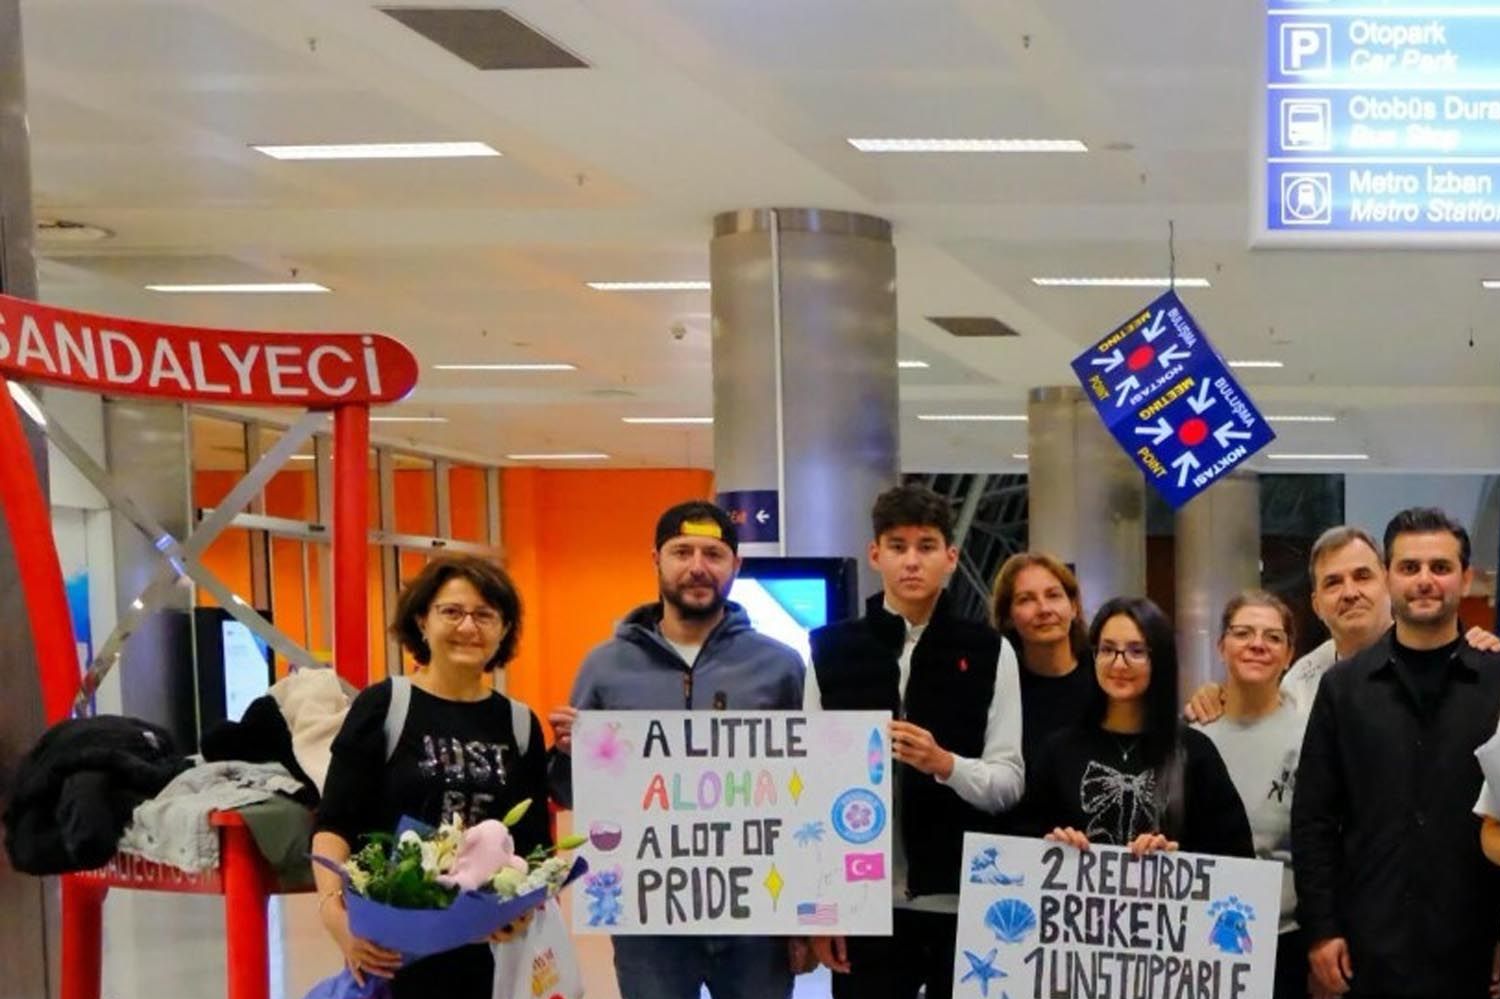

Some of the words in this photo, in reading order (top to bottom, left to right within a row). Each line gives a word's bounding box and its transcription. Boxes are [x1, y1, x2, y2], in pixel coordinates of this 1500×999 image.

[1350, 19, 1446, 48] Otopark
[1349, 95, 1436, 121] Otobüs
[1349, 169, 1420, 193] Metro
[1426, 164, 1493, 193] İzban
[1350, 198, 1420, 222] Metro
[1138, 377, 1196, 421] MEETING
[1214, 377, 1256, 428] BULUŞMA
[1137, 446, 1168, 479] POINT
[1192, 444, 1247, 488] NOKTASI
[643, 719, 671, 758] A
[684, 717, 808, 758] LITTLE
[417, 735, 509, 785] JUST
[642, 768, 778, 812] ALOHA
[636, 826, 662, 860] A
[670, 822, 731, 858] LOT
[743, 818, 782, 856] OF
[637, 866, 754, 925] PRIDE
[1040, 847, 1068, 891] 2
[1076, 850, 1216, 901] RECORDS
[1039, 894, 1188, 952] BROKEN
